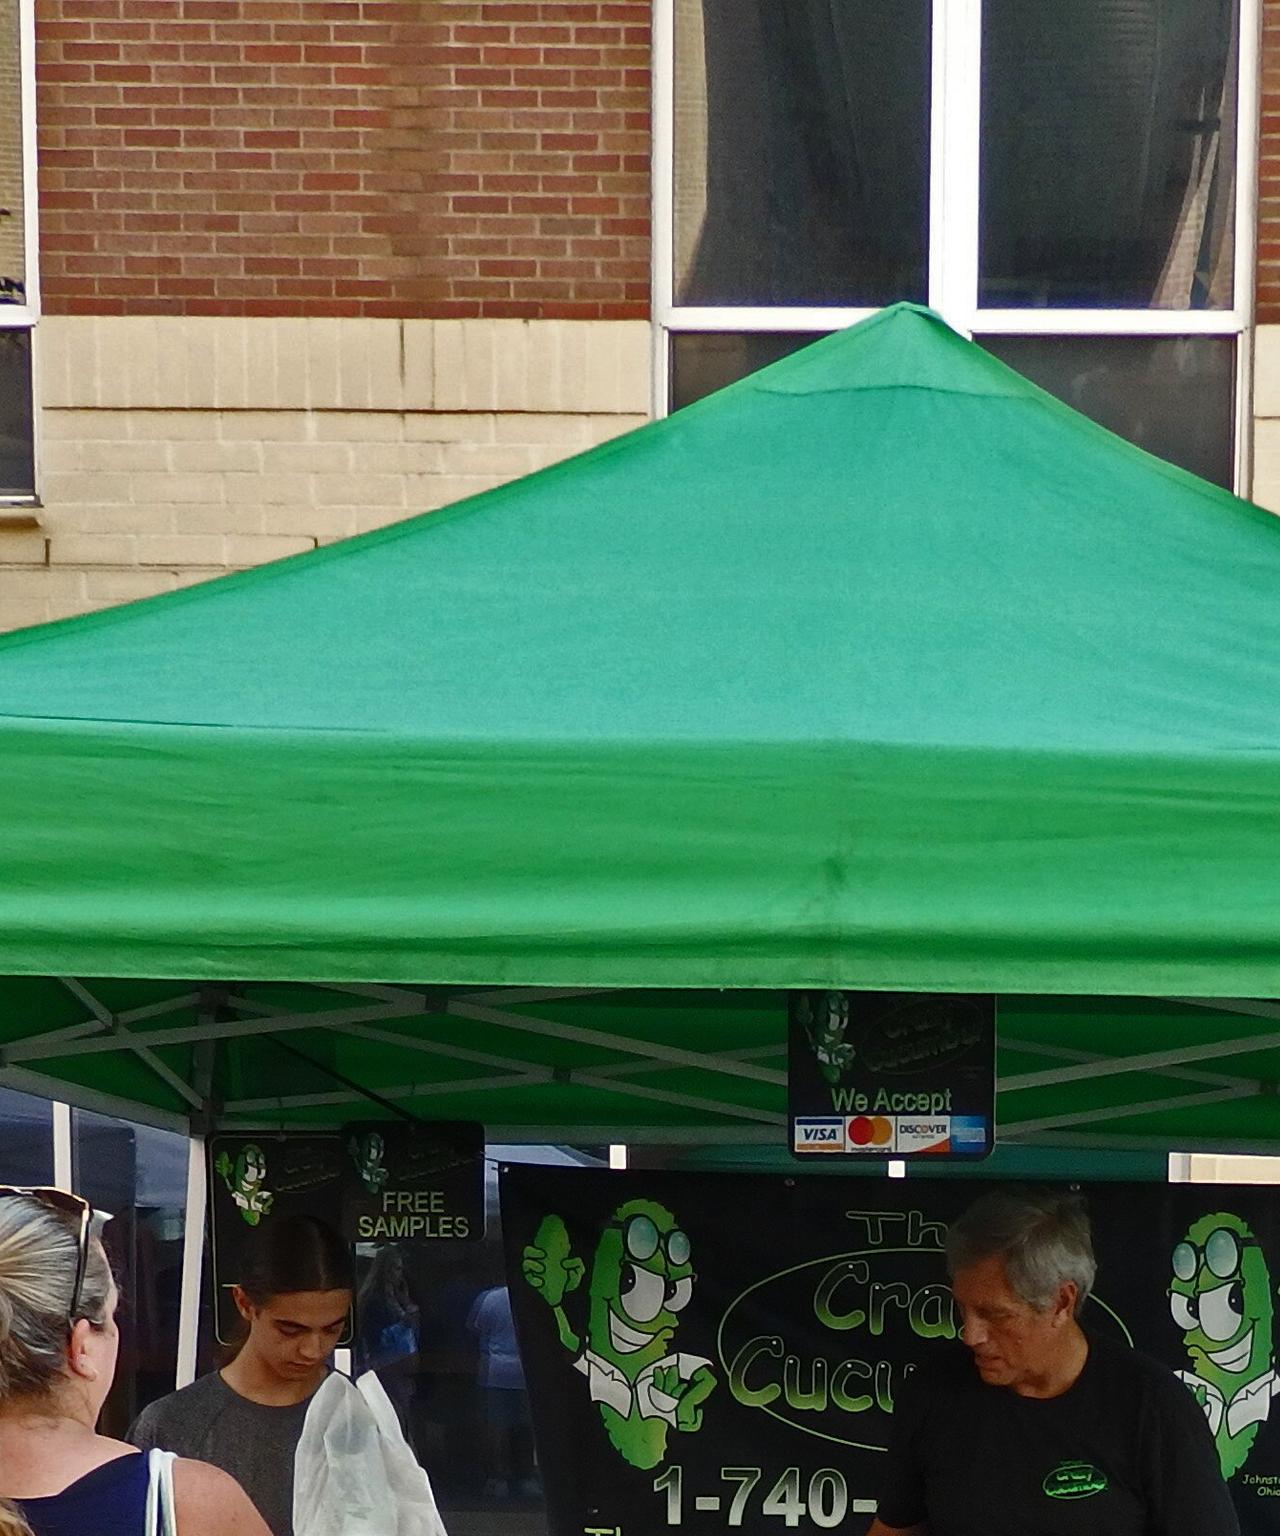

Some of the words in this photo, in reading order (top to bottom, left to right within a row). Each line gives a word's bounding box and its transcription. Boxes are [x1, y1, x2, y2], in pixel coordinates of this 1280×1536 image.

[831, 1088, 869, 1112] We
[872, 1088, 953, 1116] Accept
[803, 1128, 838, 1141] VISA
[899, 1124, 947, 1134] DISCOVER
[383, 1191, 445, 1213] FREE
[357, 1215, 470, 1239] SAMPLES
[846, 1210, 949, 1246] Th
[814, 1260, 965, 1339] Cra
[653, 1465, 879, 1528] 1-740-
[1257, 1486, 1280, 1496] Ohio
